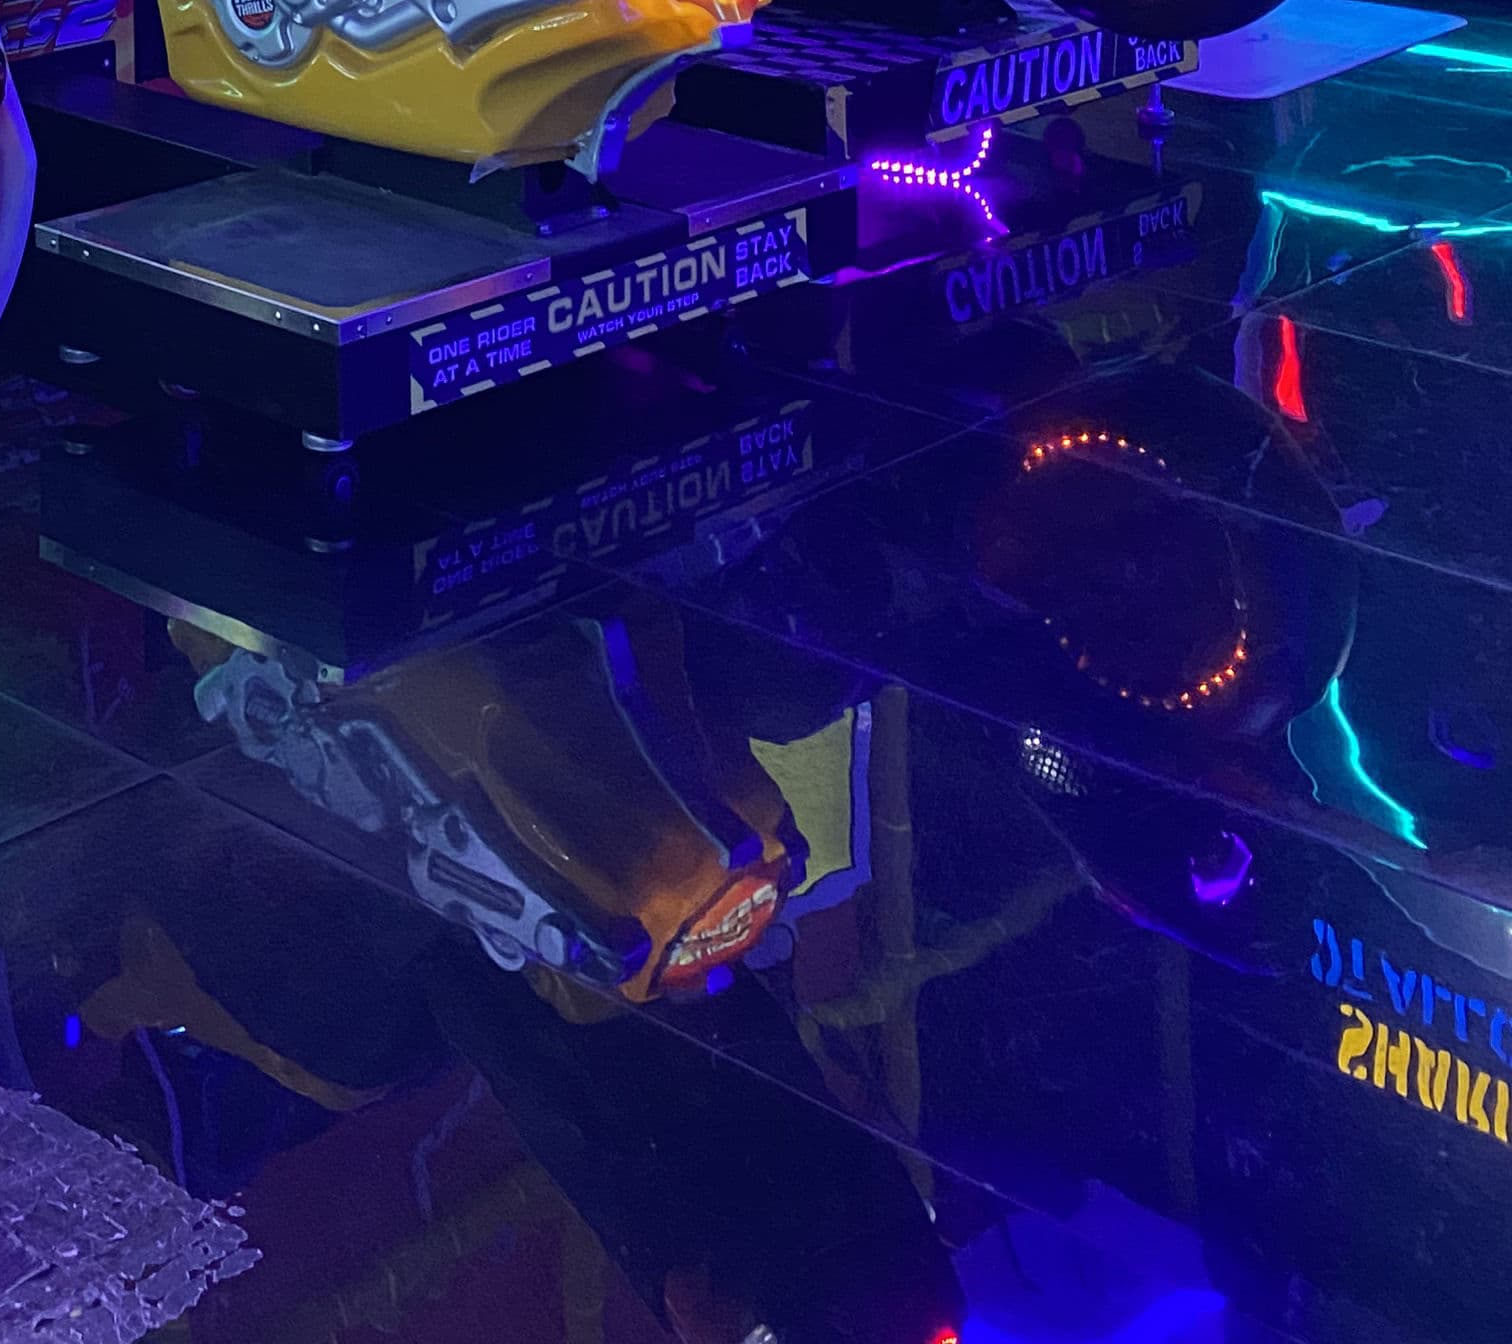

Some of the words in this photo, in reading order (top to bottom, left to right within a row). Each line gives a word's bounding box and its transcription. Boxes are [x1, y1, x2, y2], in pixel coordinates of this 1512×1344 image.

[941, 31, 1102, 126] CAUTION
[1135, 39, 1181, 72] BACK
[735, 224, 792, 262] STAY
[546, 245, 727, 335] CAUTION
[735, 251, 792, 288] BACK
[428, 336, 470, 365] ONE
[475, 317, 537, 352] RIDER
[576, 318, 624, 344] WATCH
[627, 302, 665, 328] YOUR
[666, 290, 700, 315] STEP
[433, 365, 460, 387] AT
[465, 357, 480, 376] A
[486, 339, 533, 370] TIME
